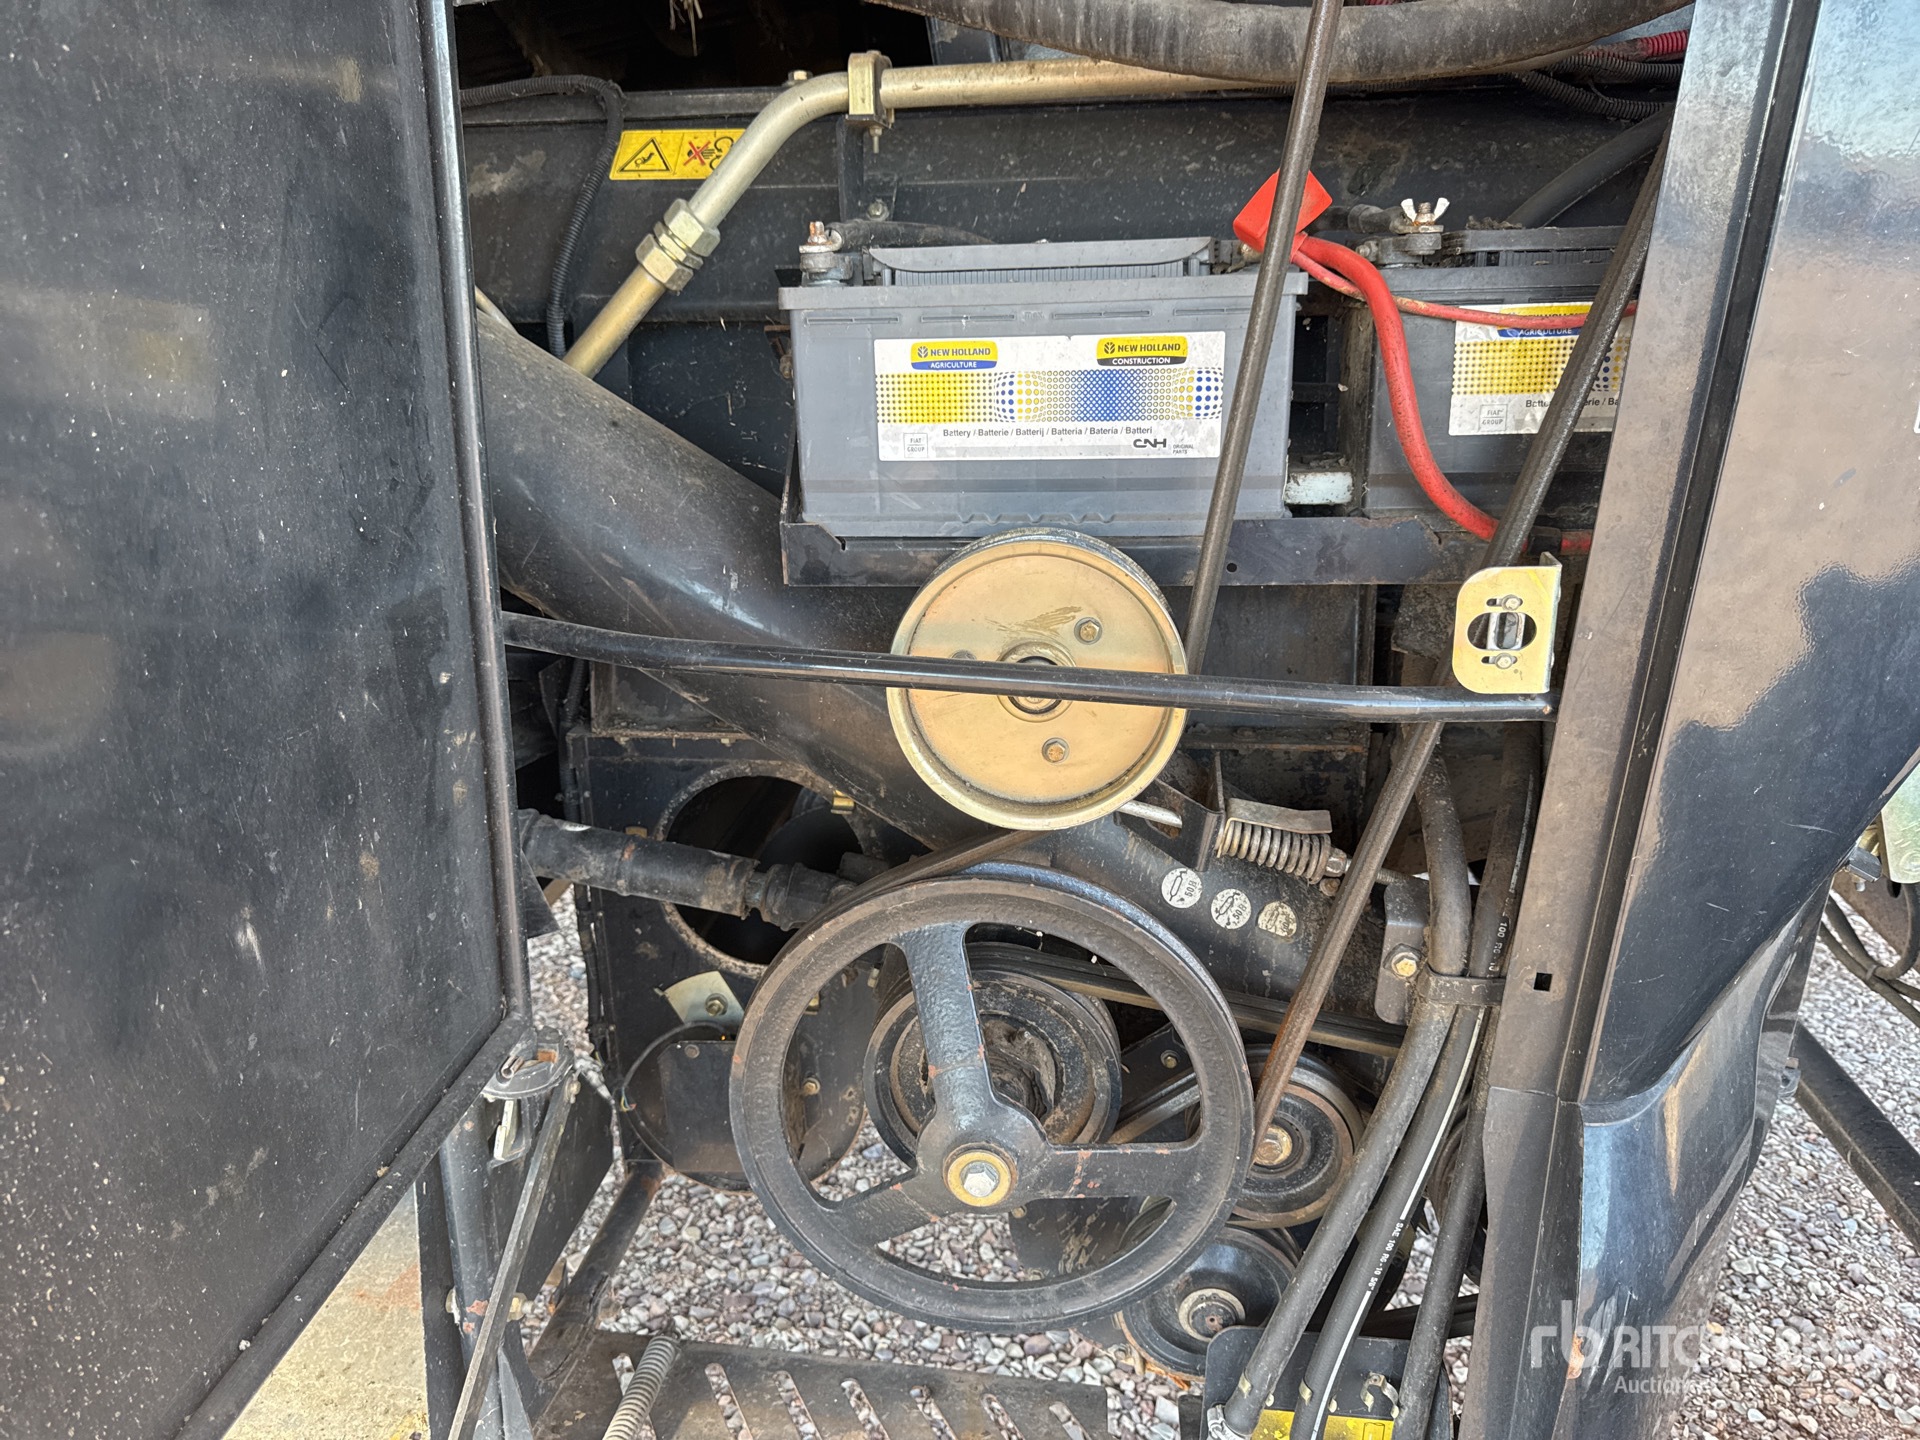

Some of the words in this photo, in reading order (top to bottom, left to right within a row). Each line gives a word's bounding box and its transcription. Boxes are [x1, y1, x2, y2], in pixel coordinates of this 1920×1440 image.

[930, 348, 950, 357] NEW
[951, 347, 991, 356] HOLLAND
[1117, 344, 1138, 352] NEW
[1139, 343, 1181, 352] HOLLAND
[930, 361, 977, 369] AGRICULTURE
[1112, 357, 1171, 365] CONSTRUCTION
[943, 429, 971, 438] Battery
[978, 428, 1009, 436] Batterie
[1015, 428, 1044, 437] Batterij
[1133, 438, 1167, 448] CNH
[1385, 1239, 1395, 1251] 100
